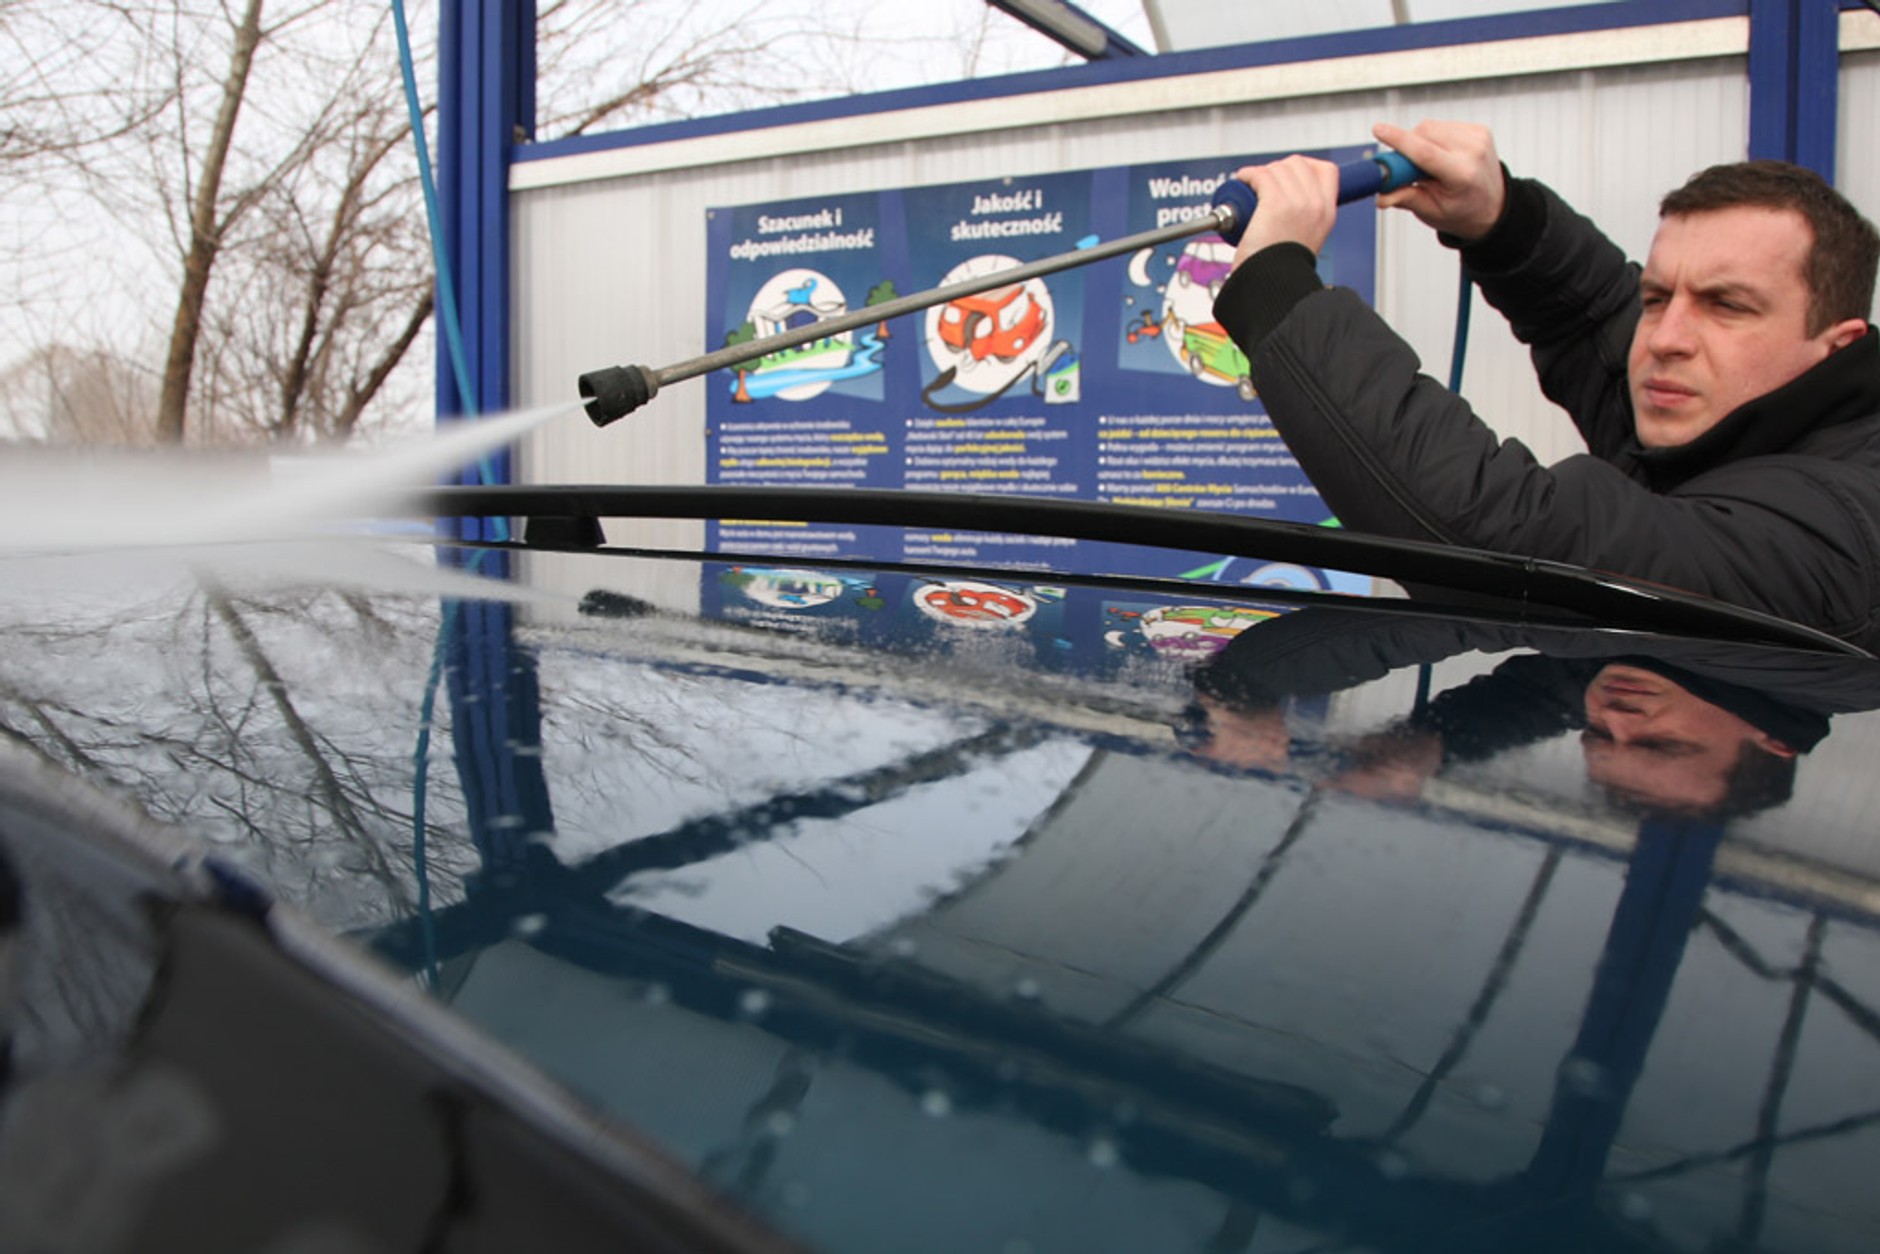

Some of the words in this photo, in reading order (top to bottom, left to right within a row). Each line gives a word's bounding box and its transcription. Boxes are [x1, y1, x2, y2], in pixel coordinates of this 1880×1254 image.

[971, 189, 1032, 215] Jakość
[1035, 188, 1042, 209] i
[1156, 202, 1213, 228] prost
[758, 208, 833, 235] Szacunek
[835, 207, 843, 226] i
[951, 211, 1063, 241] skuteczność
[730, 228, 874, 261] odpowiedzialność
